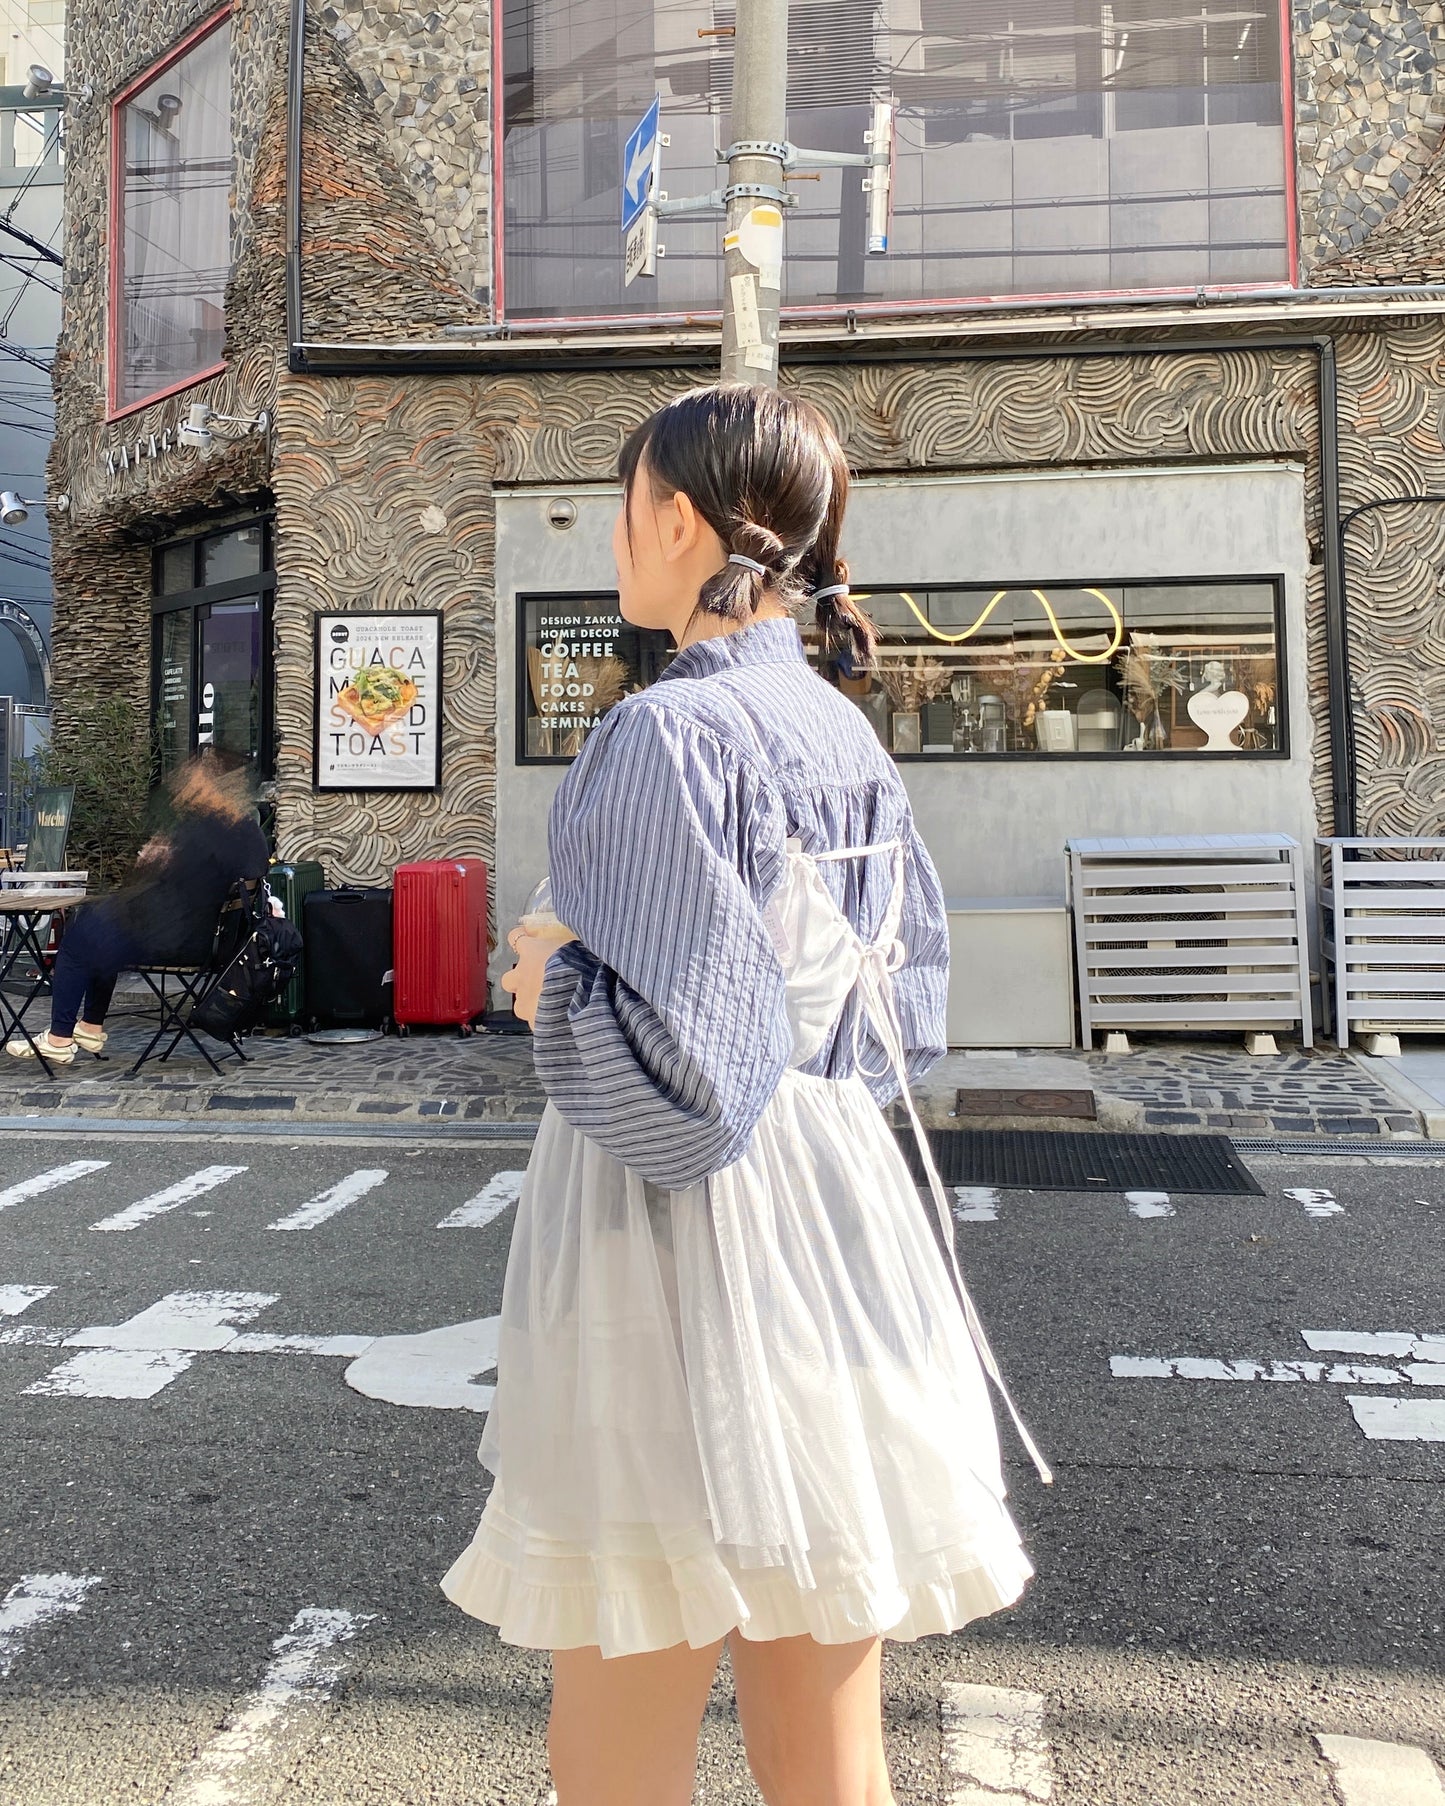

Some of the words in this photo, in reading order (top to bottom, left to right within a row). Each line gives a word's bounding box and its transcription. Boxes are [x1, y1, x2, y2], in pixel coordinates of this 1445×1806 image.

[540, 616, 580, 625] DESIGN
[584, 616, 622, 624] ZAKKA
[540, 630, 576, 638] HOME
[580, 628, 620, 638] DECOR
[541, 642, 614, 658] COFFEE
[330, 646, 426, 671] GUACA
[541, 663, 579, 678] TEA
[541, 683, 594, 697] FOOD
[542, 702, 585, 712] CAKES
[330, 732, 426, 756] TOAST
[38, 809, 65, 827] Matcha
